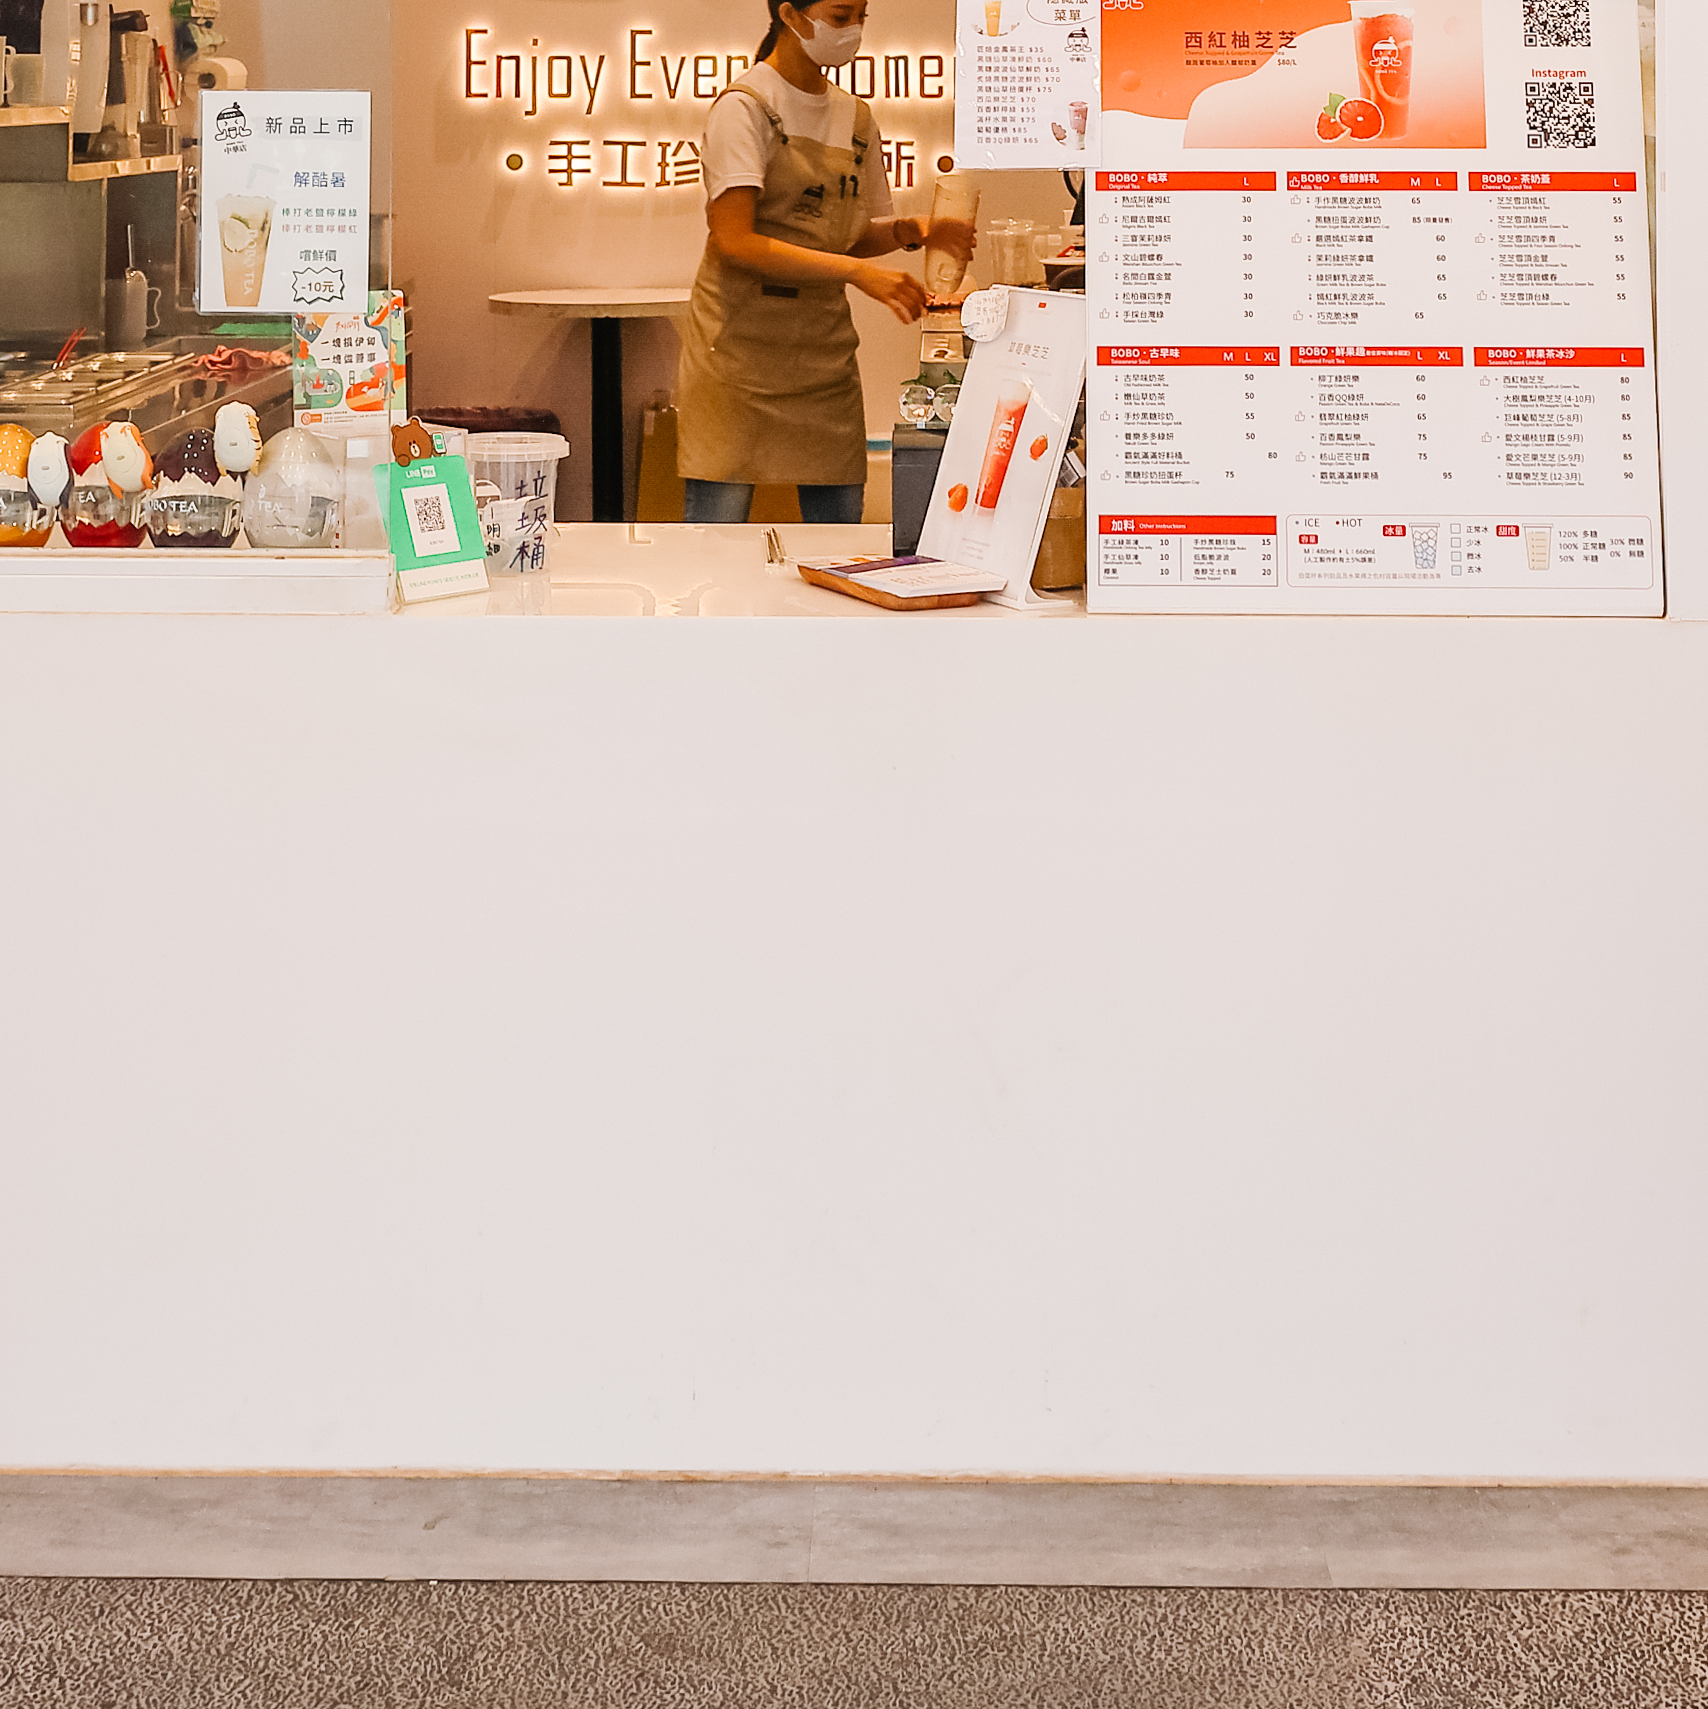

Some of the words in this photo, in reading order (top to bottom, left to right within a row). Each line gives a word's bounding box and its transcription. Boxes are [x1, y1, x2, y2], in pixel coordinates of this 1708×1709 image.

[1054, 9, 1082, 21] 菜單
[1184, 30, 1297, 49] 西紅柚芝芝
[465, 28, 605, 117] Enjoy
[629, 28, 750, 100] Ever
[1531, 68, 1586, 80] Instagram
[265, 116, 354, 135] 新品上市
[293, 171, 346, 189] 解酷暑
[1108, 173, 1138, 183] BOBO
[1300, 174, 1330, 183] BOBO
[1339, 173, 1380, 184] 香醇鮮乳
[1410, 177, 1421, 186] M
[1435, 177, 1442, 186] L
[1481, 174, 1511, 183] BOBO
[1520, 173, 1551, 184] 茶奶蓋
[281, 207, 358, 218] 棒打老鹽檸檬綠
[281, 223, 358, 234] 棒打老鹽檸檬紅
[1243, 253, 1253, 261] 30
[1110, 348, 1140, 358] BOBO
[1149, 348, 1181, 359] 古早味
[1223, 352, 1234, 361] M
[1244, 352, 1251, 361] L
[1263, 352, 1277, 362] XL
[1298, 347, 1328, 357] BOBO
[1438, 351, 1451, 361] XL
[1487, 349, 1517, 359] BOBO
[1525, 349, 1576, 359] 鮮果茶冰沙
[1123, 374, 1165, 382] 古早味奶茶
[1503, 375, 1545, 384] 西紅柚芝芝
[1319, 433, 1361, 441] 百香鳳梨樂
[1417, 433, 1427, 441] 75
[1623, 453, 1633, 461] 85
[405, 469, 421, 479] LINE
[170, 501, 199, 514] TEA
[509, 470, 549, 573] 垃圾桶
[1111, 519, 1135, 532] 加料
[1304, 518, 1320, 527] ICE
[1342, 518, 1363, 527] HOT
[1385, 526, 1404, 536] 冰量
[1466, 525, 1489, 534] 正常冰
[1498, 525, 1517, 536] 甜度
[1582, 542, 1606, 550] 正常糖
